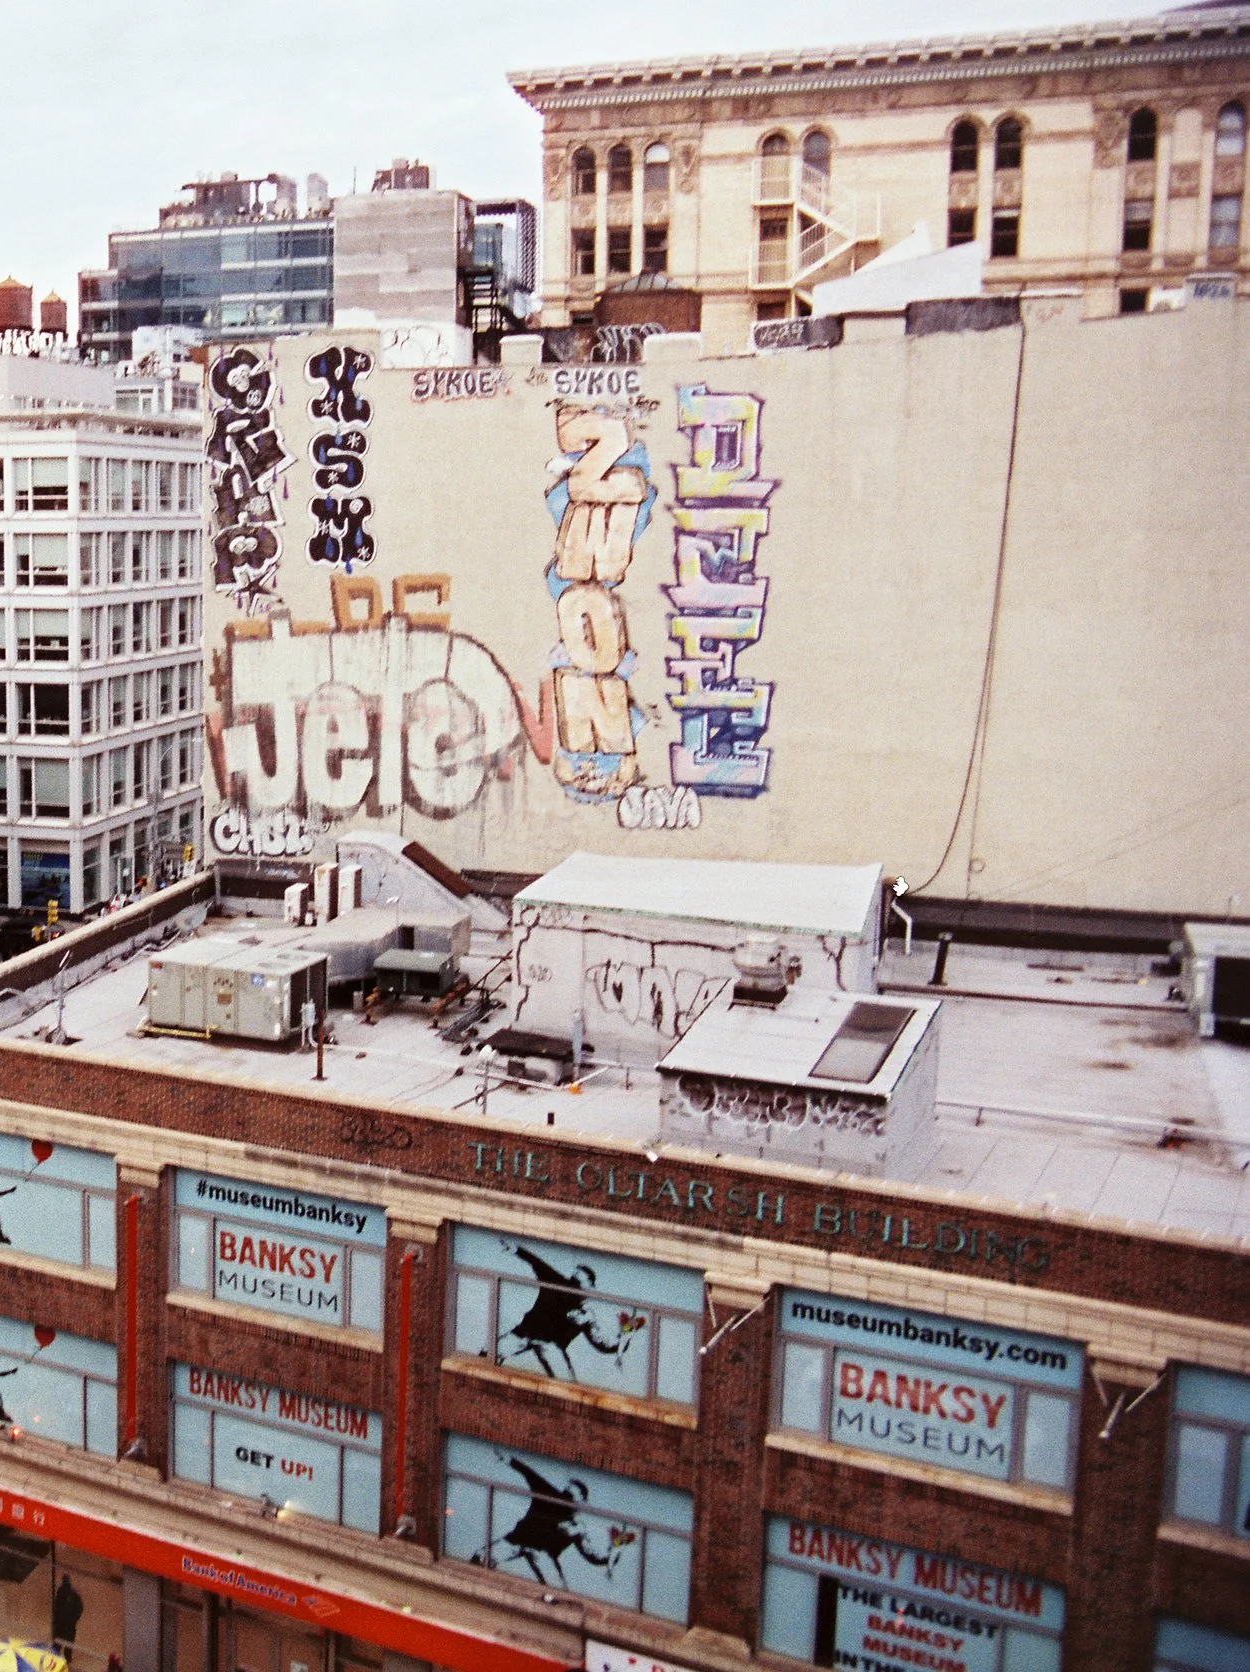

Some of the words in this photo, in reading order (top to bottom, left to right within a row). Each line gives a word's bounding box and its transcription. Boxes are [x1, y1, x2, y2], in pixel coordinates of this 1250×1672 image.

[196, 1178, 367, 1234] #museumbanksy
[468, 1141, 549, 1181] THE
[576, 1161, 785, 1225] OLTARSH
[813, 1202, 1049, 1269] BUILDING
[219, 1230, 338, 1284] BANKSY
[218, 1269, 338, 1313] MUSEUM
[791, 1300, 1068, 1371] museumbanksy.com
[189, 1367, 270, 1413] BANKSY
[278, 1390, 369, 1440] MUSEUM
[839, 1361, 1007, 1430] BANKSY
[836, 1407, 1006, 1464] MUSEUM
[235, 1446, 275, 1469] GET
[280, 1457, 314, 1481] UP!
[181, 1556, 217, 1582] Bank
[236, 1574, 297, 1607] America
[788, 1522, 902, 1580] BANKSY
[913, 1552, 1044, 1618] MUSEUM
[838, 1584, 883, 1610] THE
[888, 1596, 1000, 1639] LARGEST
[867, 1613, 964, 1653] BANKSY
[863, 1634, 966, 1672] MUSEUM
